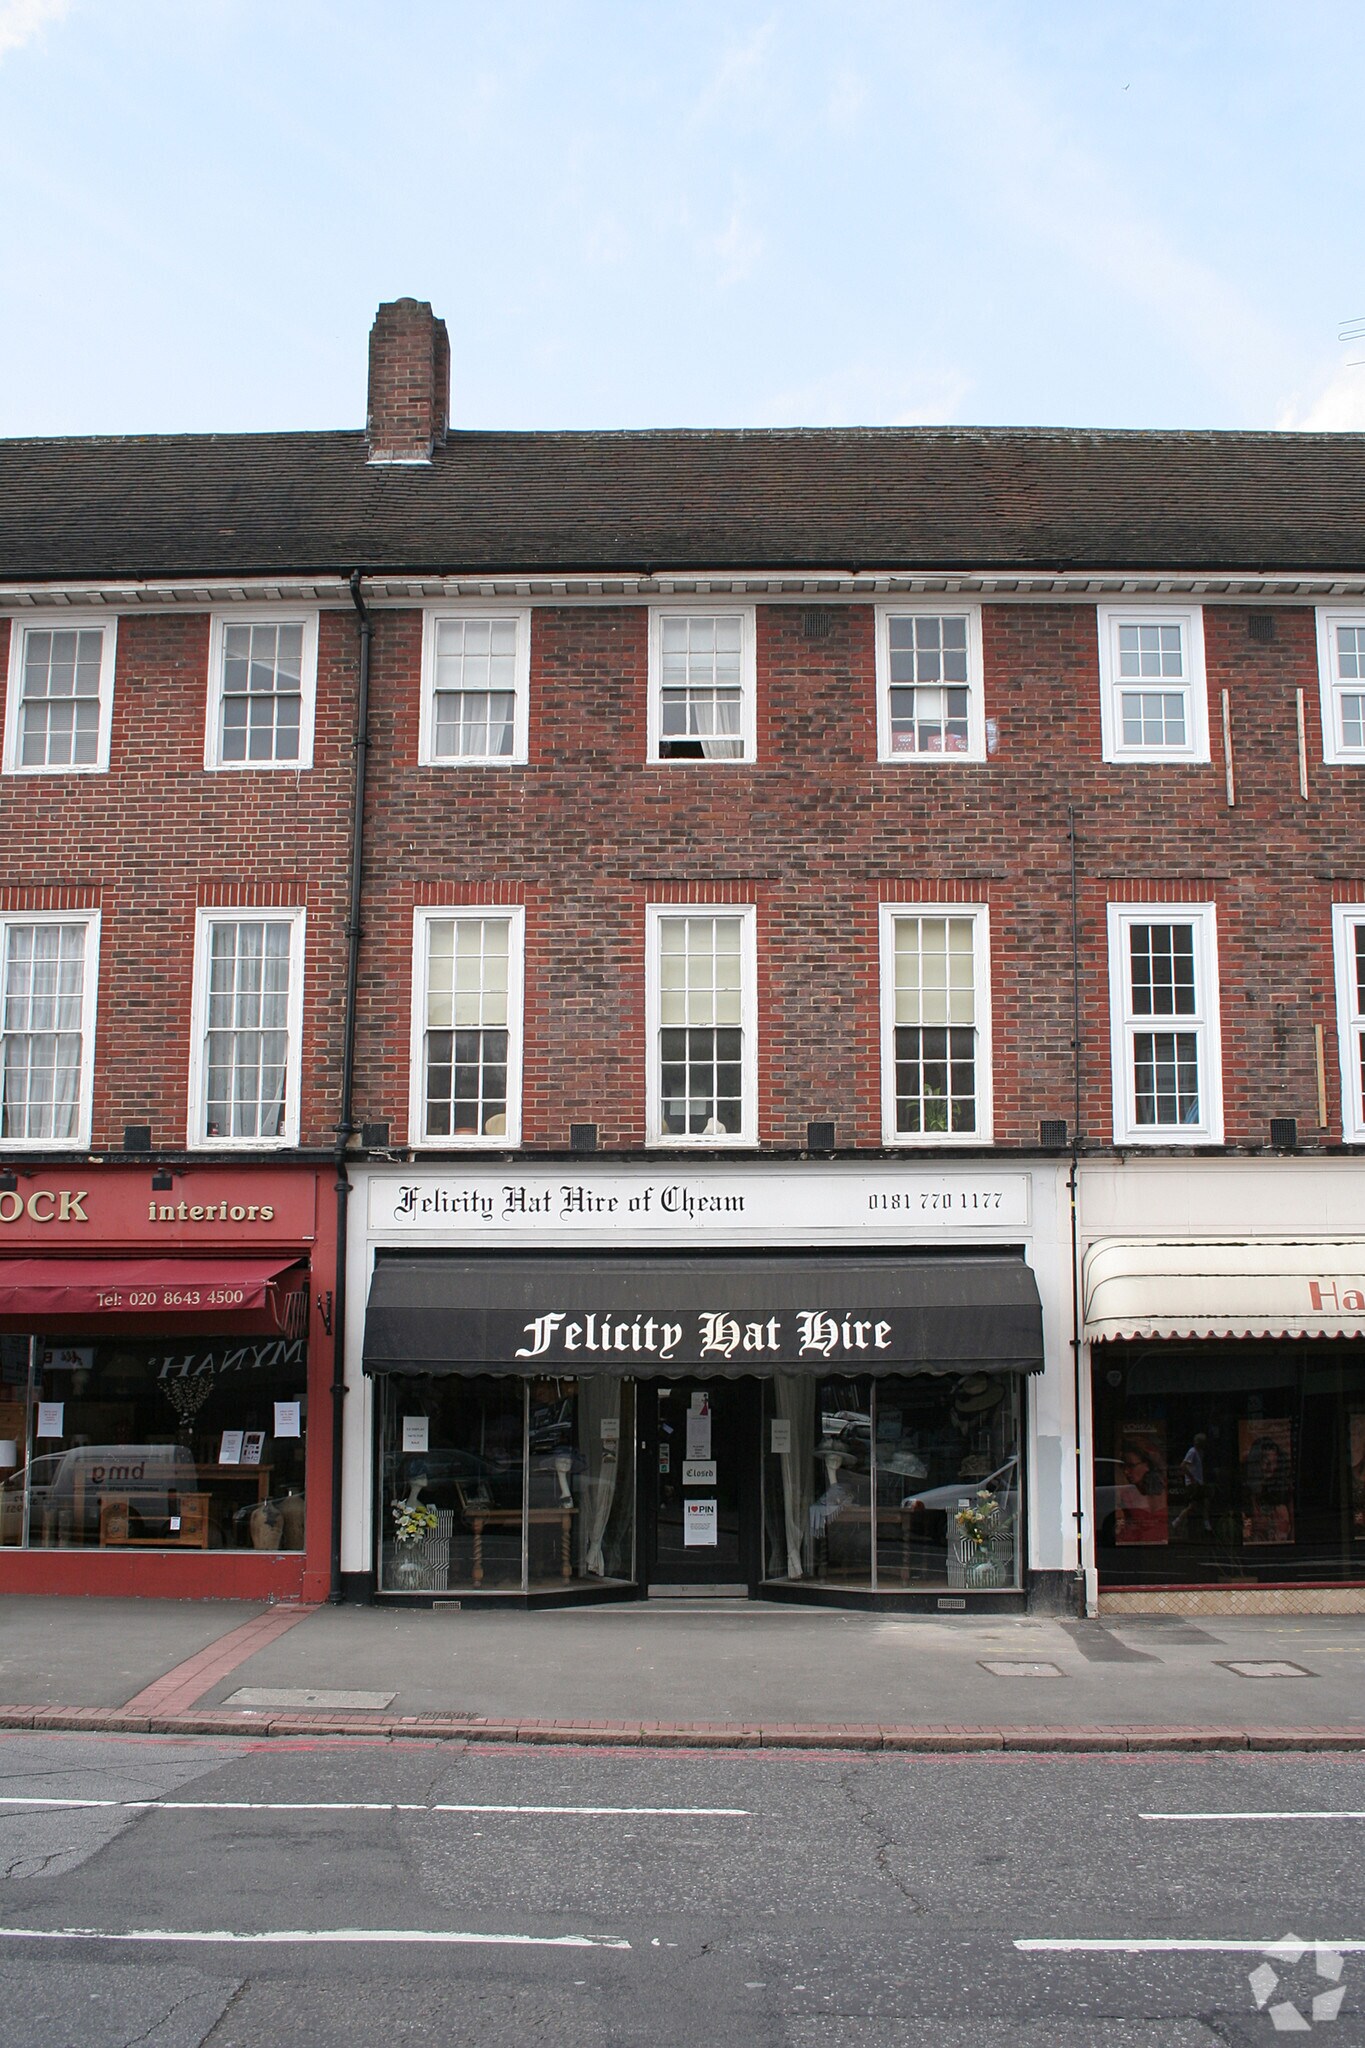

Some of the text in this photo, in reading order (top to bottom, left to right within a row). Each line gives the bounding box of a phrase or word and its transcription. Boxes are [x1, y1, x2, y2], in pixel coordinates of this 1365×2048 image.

[0, 1191, 89, 1223] OCK
[148, 1200, 275, 1222] interiors
[393, 1184, 745, 1221] Felicity Hat Hire of Cheam
[868, 1192, 1003, 1210] 0181 770 1177
[96, 1290, 243, 1307] Tel: 020 8643 4500
[1308, 1281, 1365, 1311] Ha
[515, 1310, 892, 1359] Felicity Hat Hire
[686, 1468, 714, 1478] Closed
[699, 1505, 714, 1513] PIN
